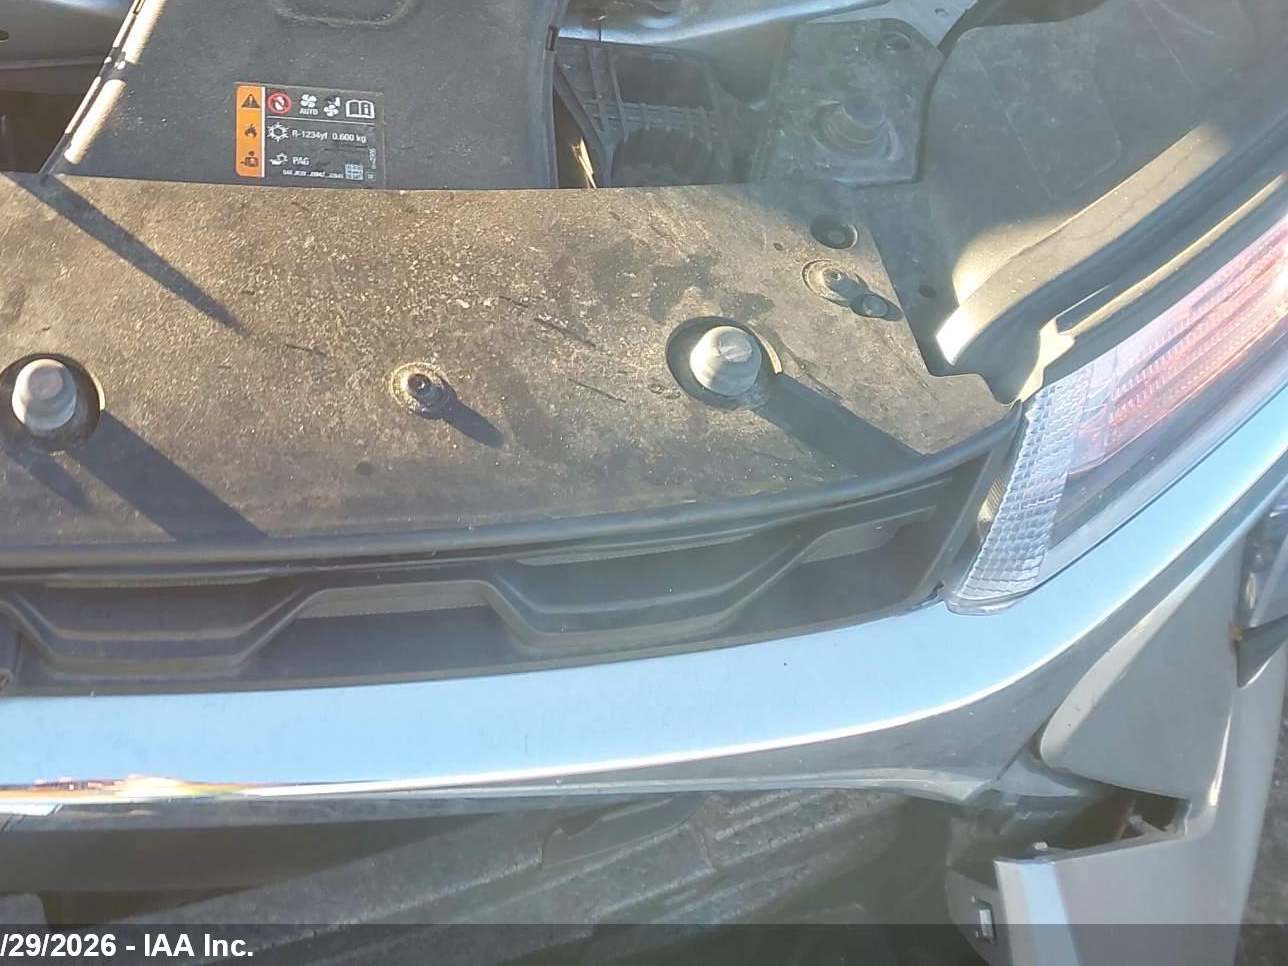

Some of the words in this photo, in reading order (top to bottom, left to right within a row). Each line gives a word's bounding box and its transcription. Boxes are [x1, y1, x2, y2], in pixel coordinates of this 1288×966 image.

[299, 108, 319, 116] AUTO
[291, 129, 328, 139] R-1234yf
[331, 133, 355, 142] 0.600
[356, 134, 367, 144] kg
[292, 156, 310, 166] PAG
